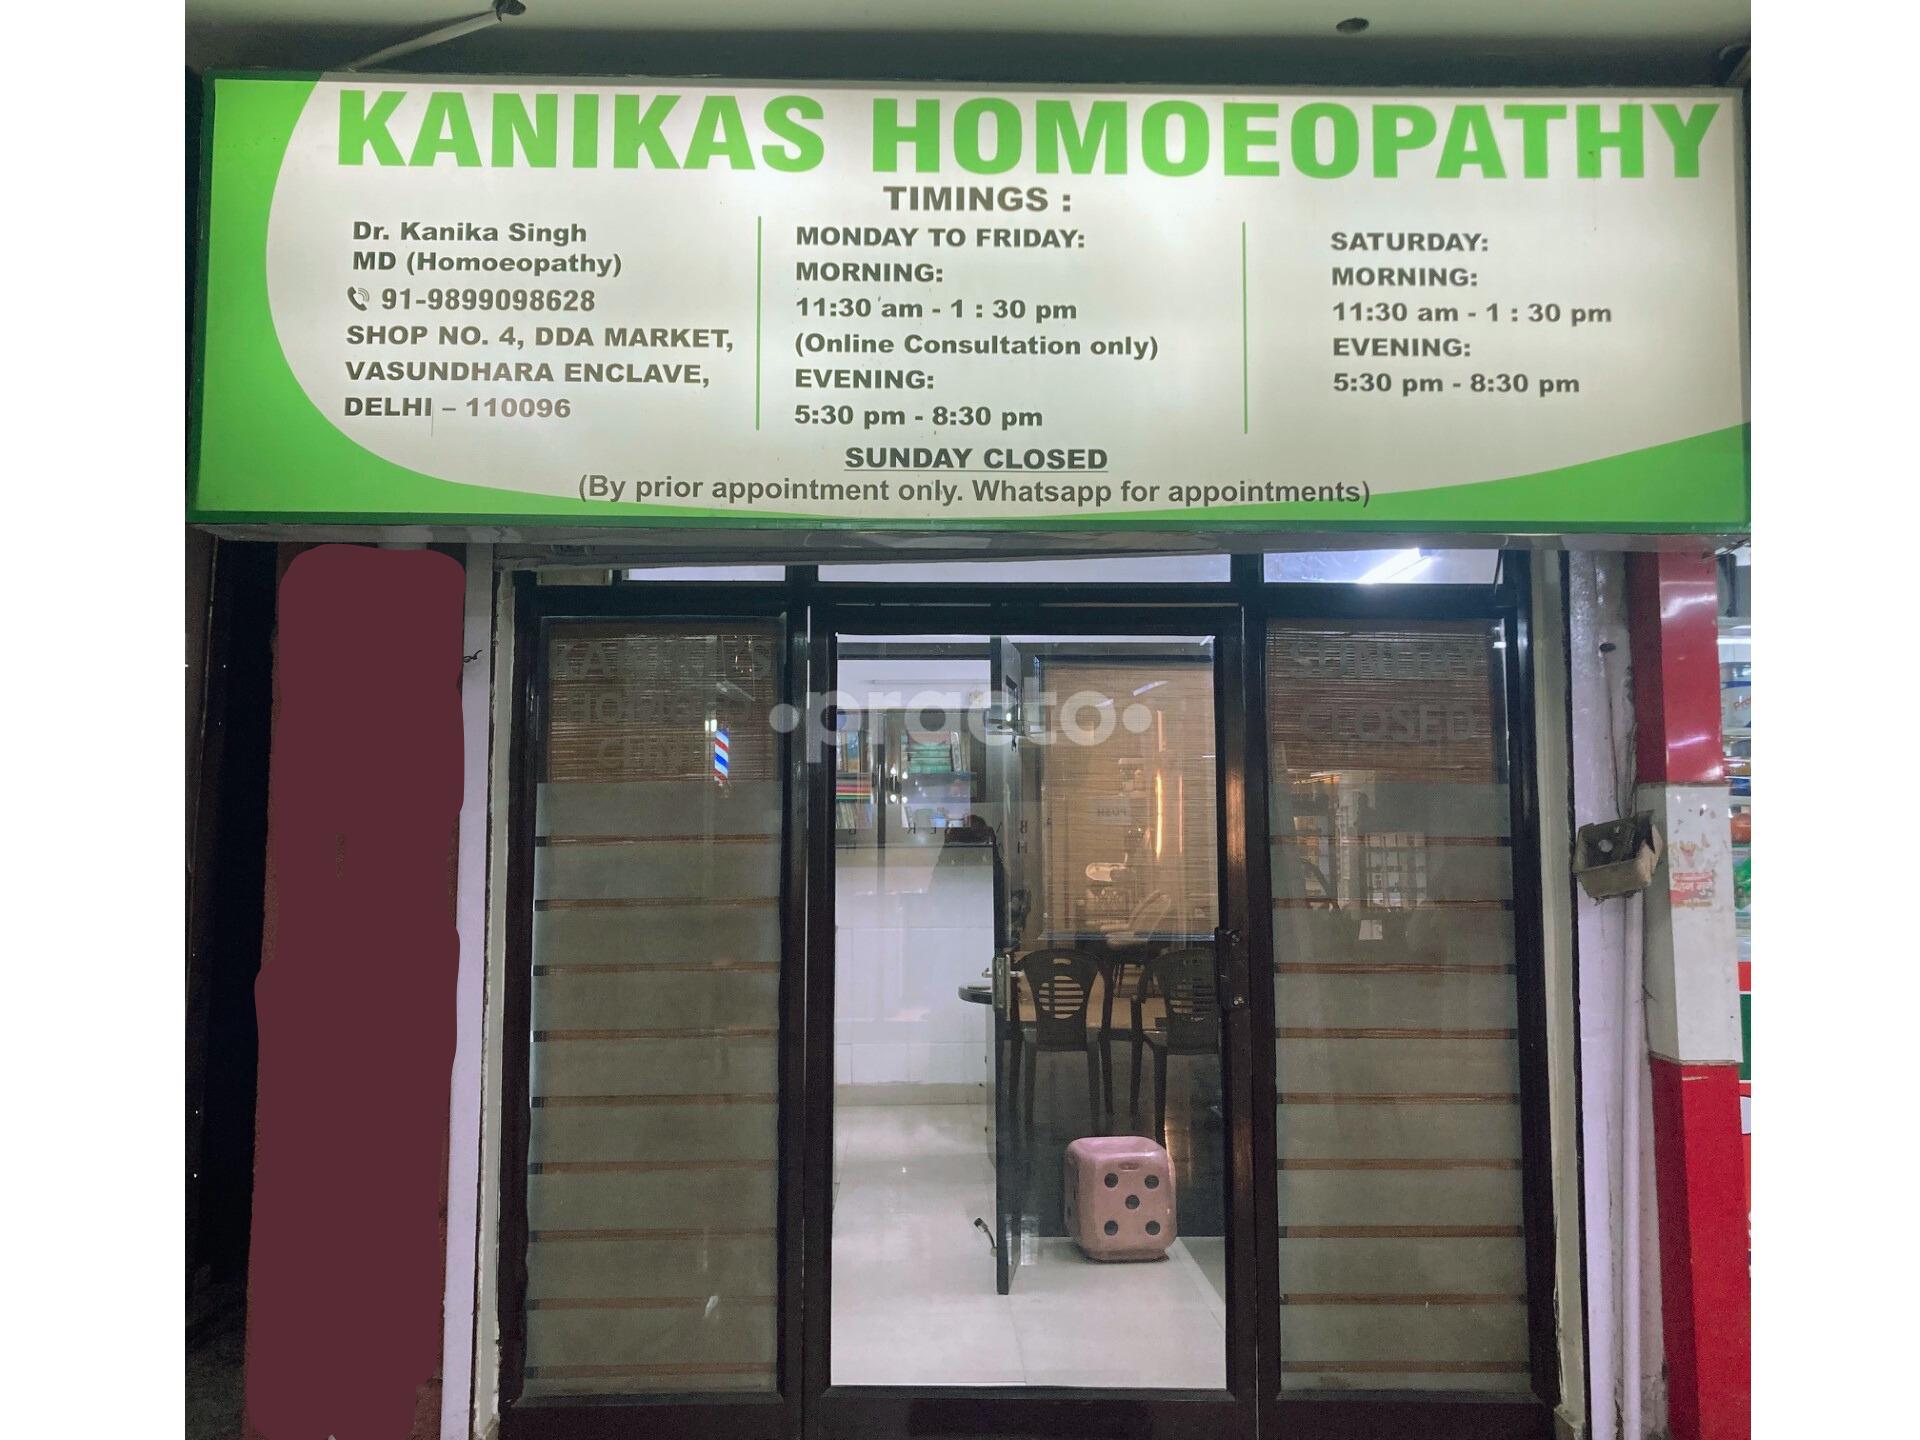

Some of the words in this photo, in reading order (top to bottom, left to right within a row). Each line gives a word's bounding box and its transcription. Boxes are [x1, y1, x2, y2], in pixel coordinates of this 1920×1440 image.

[338, 90, 824, 172] KANIKAS
[873, 98, 1719, 179] HOMOEOPATHY
[882, 186, 1049, 213] TIMINGS
[352, 221, 390, 241] Dr.
[400, 221, 499, 242] Kanika
[508, 222, 587, 247] Singh
[796, 226, 920, 247] MONDAY
[927, 227, 967, 248] TO
[976, 228, 1085, 249] FRIDAY:
[1330, 231, 1489, 252] SATURDAY:
[352, 251, 397, 271] MD
[406, 251, 622, 278] (Homoeopathy)
[796, 261, 943, 283] MORNING:
[1331, 266, 1478, 287] MORNING:
[381, 287, 595, 312] 91-9899098628
[796, 297, 872, 318] 11:30
[880, 303, 923, 318] am
[950, 298, 963, 319] 1
[992, 299, 1026, 319] 30
[1035, 304, 1077, 324] pm
[1332, 301, 1408, 322] 11:30
[1417, 307, 1459, 322] am
[1486, 302, 1498, 322] 1
[1527, 303, 1561, 323] 30
[1571, 308, 1612, 328] pm
[346, 325, 428, 345] SHOP
[438, 325, 489, 346] NO.
[498, 326, 524, 351] 4,
[535, 326, 595, 347] DDA
[604, 327, 733, 353] MARKET,
[795, 332, 895, 358] (Online
[904, 333, 1081, 355] Consultation
[1090, 335, 1158, 361] only)
[1333, 337, 1471, 358] EVENING:
[345, 361, 555, 382] VASUNDHARA
[564, 362, 710, 389] ENCLAVE,
[795, 368, 934, 390] EVENING:
[1333, 372, 1392, 392] 5:30
[1402, 378, 1444, 398] pm
[1470, 373, 1529, 393] 8:30
[1539, 378, 1580, 399] pm
[344, 397, 432, 417] DELHI
[466, 397, 571, 418] 110096
[794, 404, 854, 425] 5:30
[863, 410, 906, 430] pm
[932, 405, 992, 426] 8:30
[1001, 411, 1043, 432] pm
[844, 446, 974, 469] SUNDAY
[983, 447, 1108, 470] CLOSED
[578, 474, 626, 503] (By
[636, 475, 704, 502] prior
[711, 477, 889, 504] appointment
[898, 480, 963, 507] only.
[972, 479, 1112, 506] Whatsapp
[1120, 479, 1161, 502] for
[1168, 480, 1370, 508] appointments)
[1303, 702, 1477, 740] CLOSED
